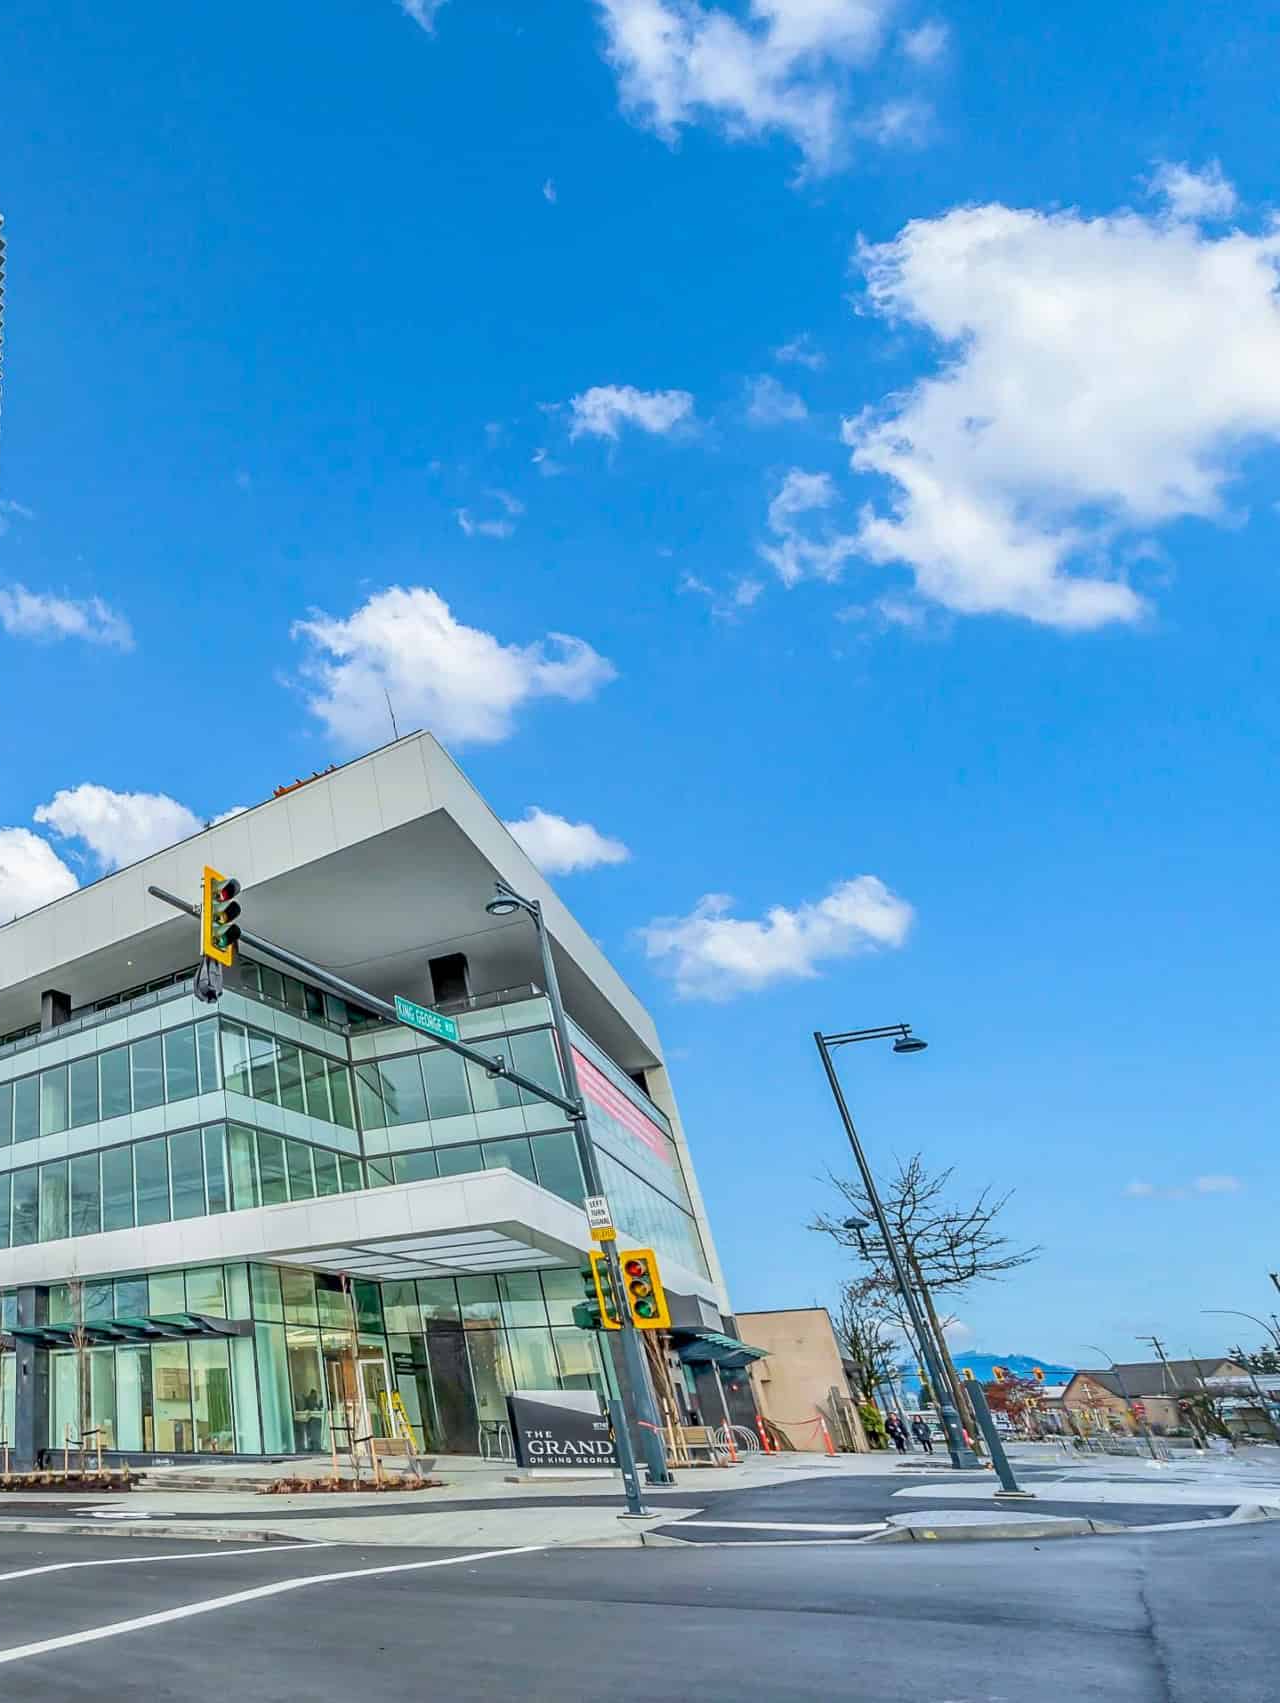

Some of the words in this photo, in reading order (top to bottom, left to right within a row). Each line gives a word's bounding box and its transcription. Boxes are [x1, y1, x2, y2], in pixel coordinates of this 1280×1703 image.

[398, 1000, 415, 1021] KING
[524, 1430, 553, 1439] THE
[527, 1440, 614, 1455] GRAND
[529, 1456, 544, 1464] ON
[548, 1456, 572, 1464] KING
[576, 1456, 617, 1464] GEORGE
